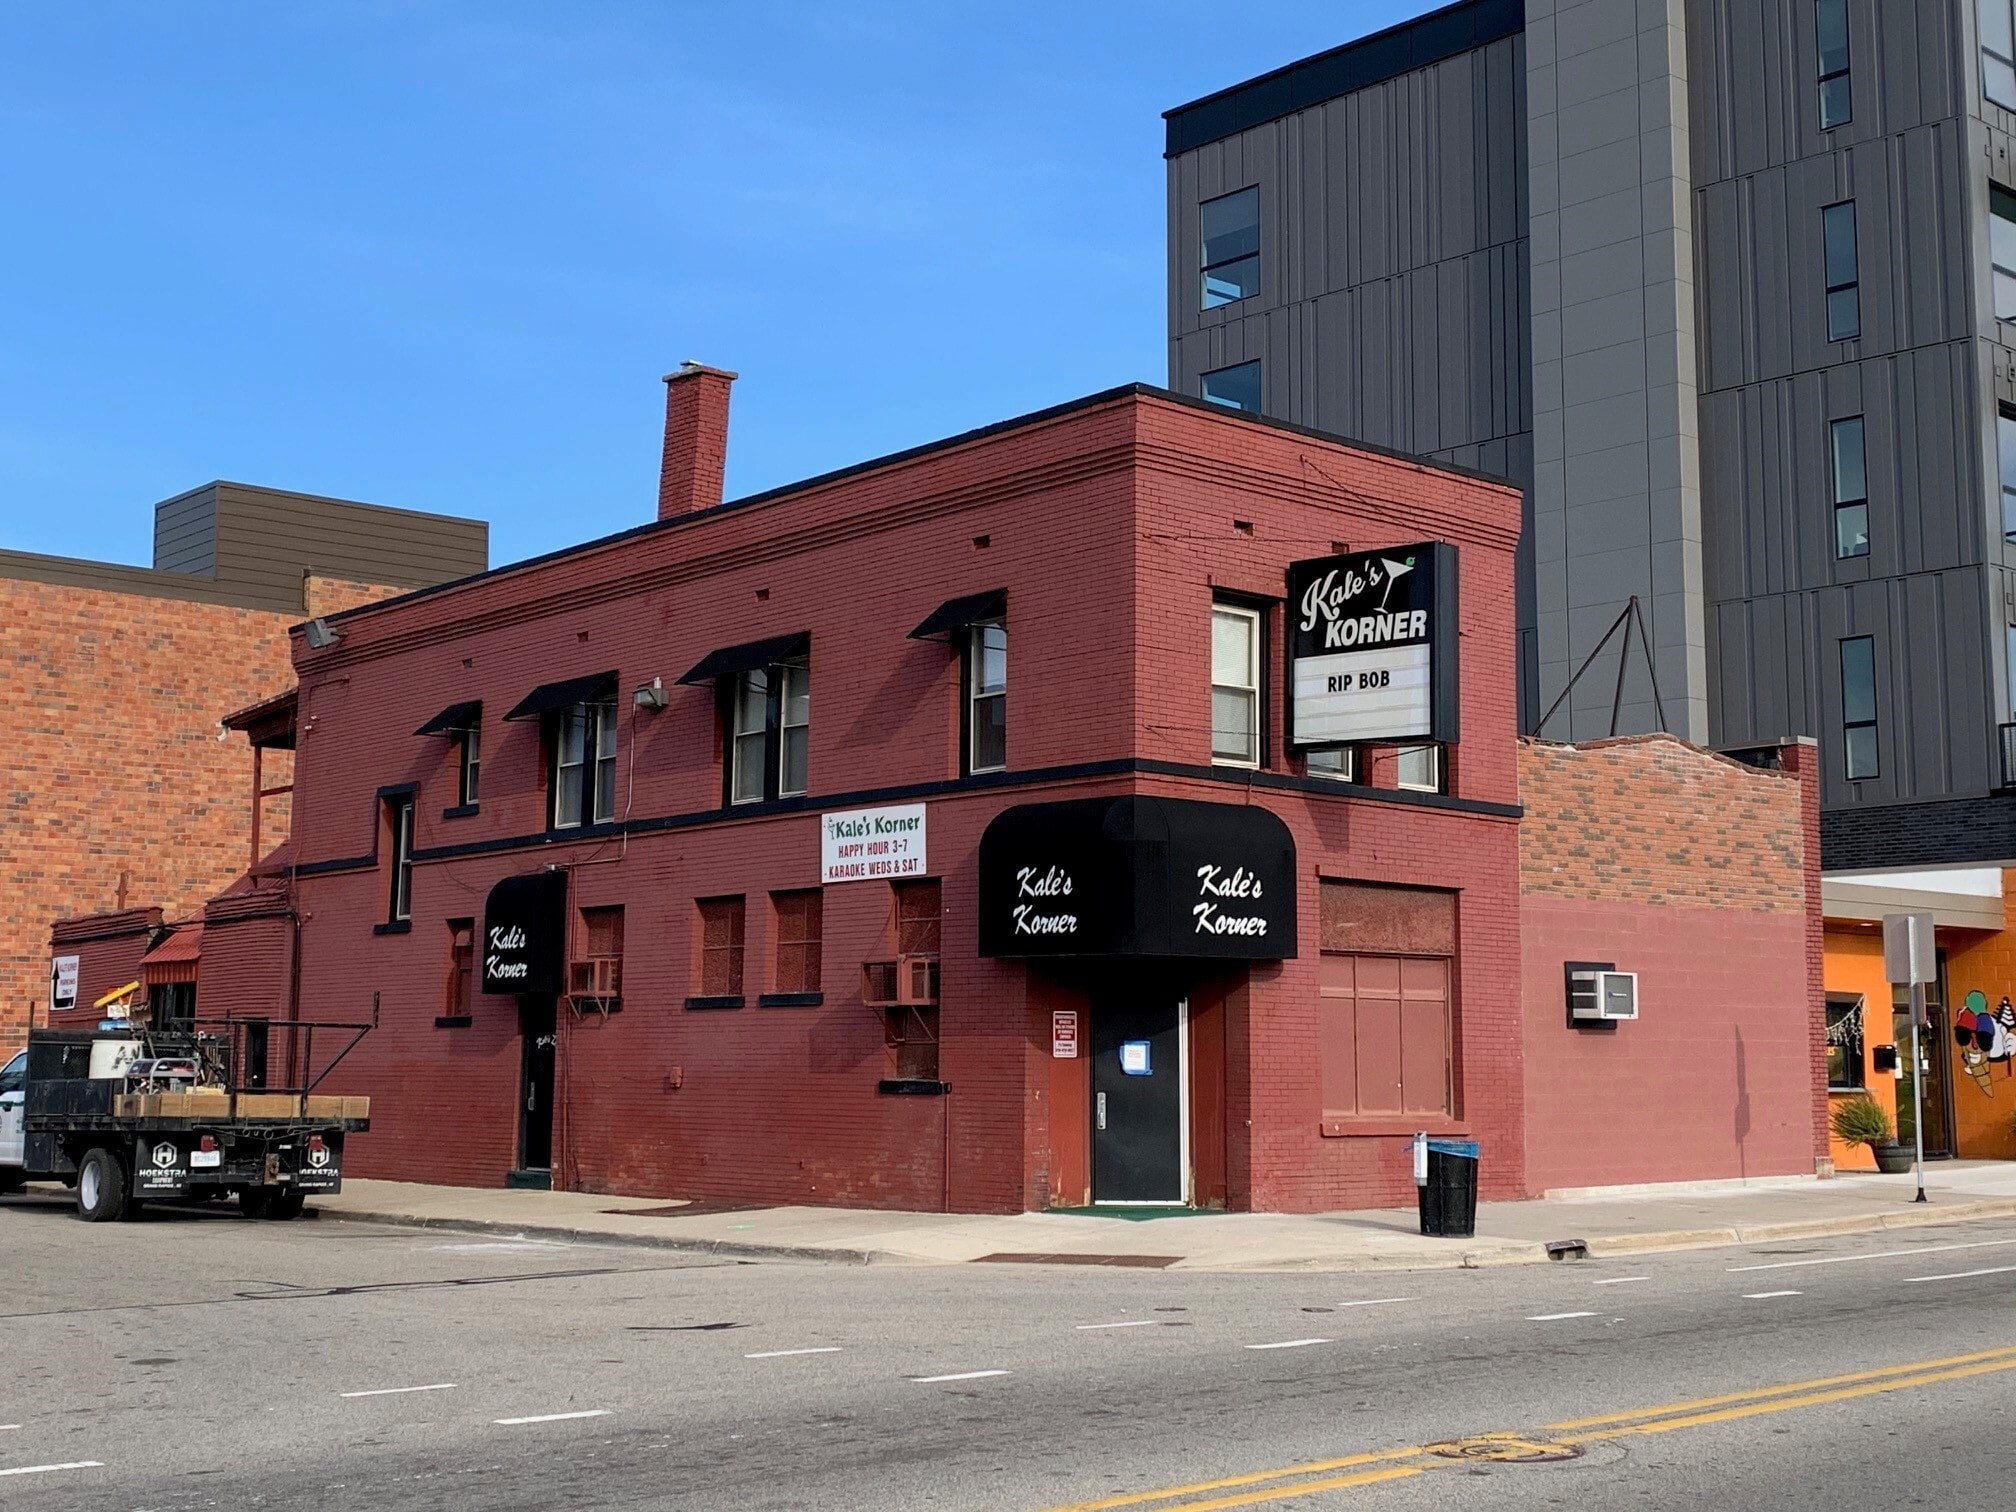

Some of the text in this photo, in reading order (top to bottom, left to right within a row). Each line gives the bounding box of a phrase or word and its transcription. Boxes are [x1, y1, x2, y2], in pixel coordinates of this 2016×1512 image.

[1300, 559, 1383, 632] Kale's
[1325, 609, 1427, 648] KORNER
[1328, 670, 1390, 692] RIP BOB
[835, 815, 920, 838] Kale's Korner
[838, 839, 908, 858] HAPPY HOUR 3-7
[829, 858, 918, 879] KARAOKE WEDS & SAT
[1016, 865, 1073, 897] Kale's
[1197, 864, 1263, 898] Kale's
[1013, 904, 1077, 935] Korner
[1192, 902, 1267, 936] Korner
[490, 925, 526, 950] Kale's
[486, 954, 528, 979] Korner
[139, 1169, 187, 1177] HOEKSTRA
[299, 1168, 339, 1177] OEKSTRA
